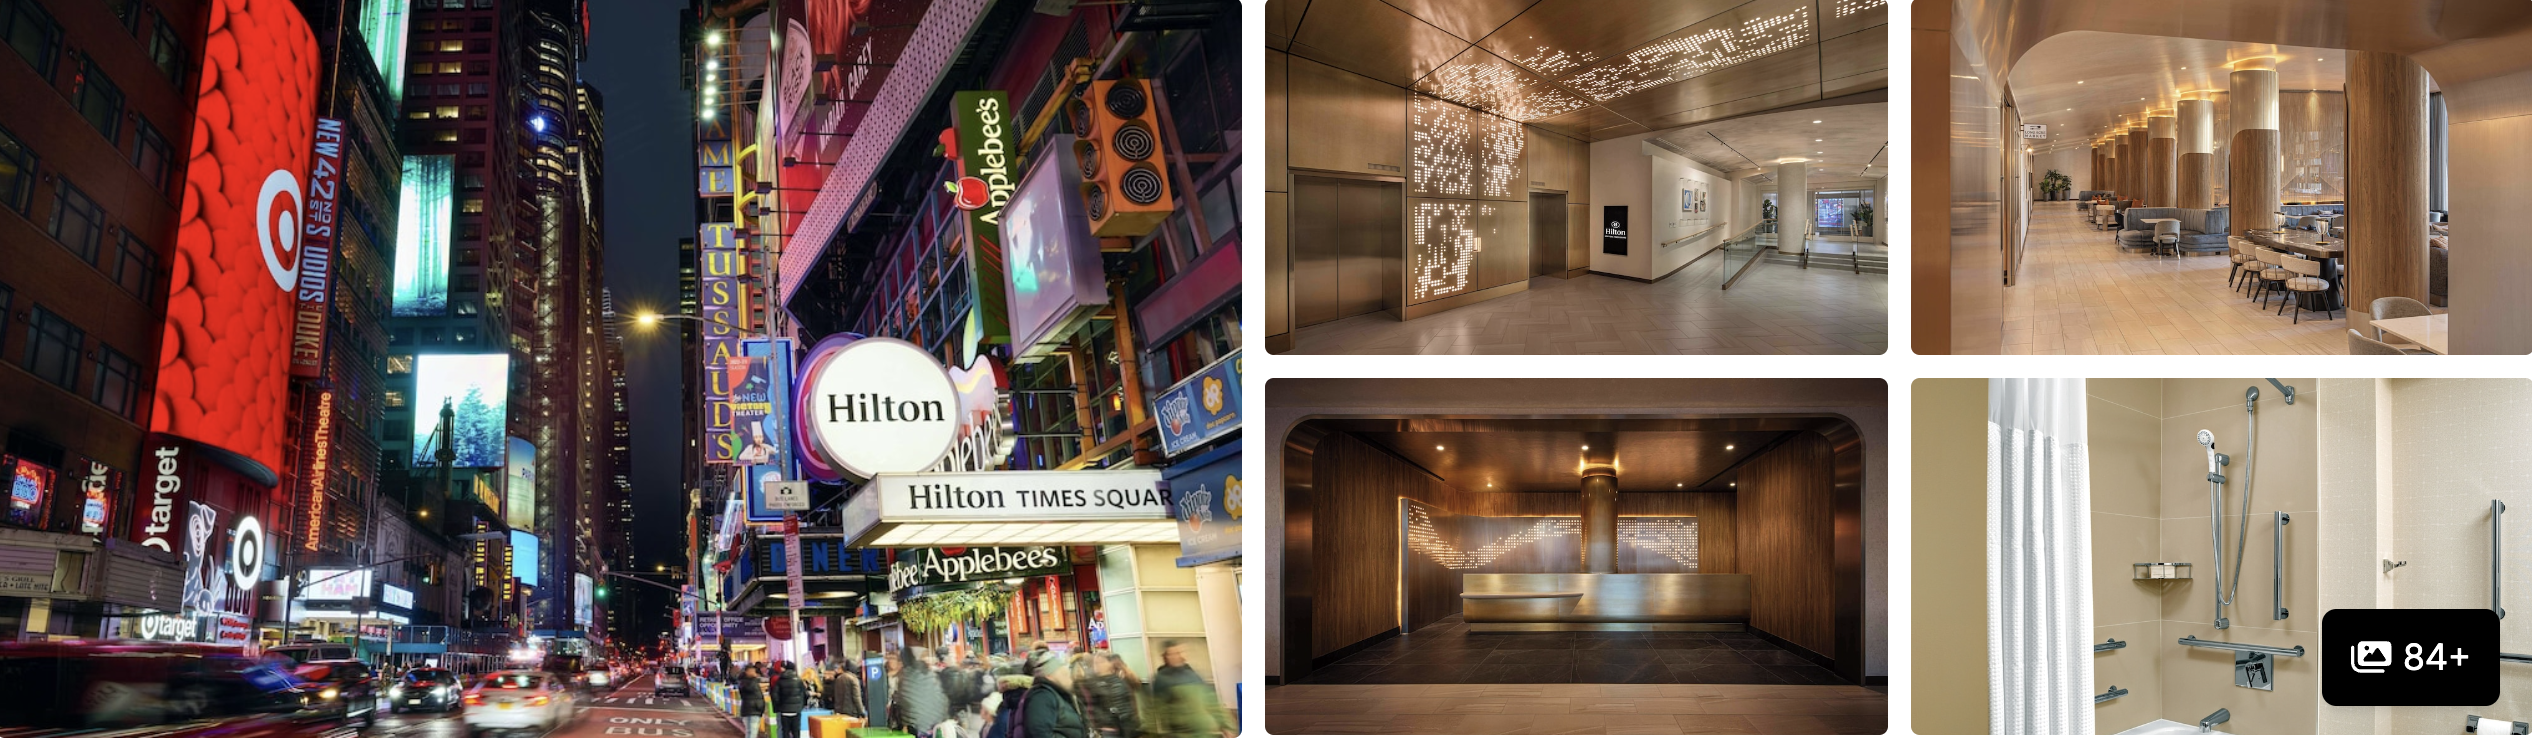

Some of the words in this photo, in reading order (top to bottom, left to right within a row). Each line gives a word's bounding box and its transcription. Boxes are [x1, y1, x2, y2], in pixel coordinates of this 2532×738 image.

[847, 36, 873, 101] CAREY
[701, 42, 732, 193] MAME
[315, 117, 342, 158] NEW
[1605, 228, 1626, 236] Hilton
[293, 310, 322, 359] DUKE
[742, 392, 766, 402] NEW
[828, 393, 945, 423] Hilton
[144, 446, 182, 536] target
[908, 485, 1005, 510] Hilton
[1016, 489, 1086, 508] TIMES
[1094, 489, 1174, 510] SQUAR
[476, 524, 487, 563] VICTY
[770, 541, 880, 573] DNER
[159, 612, 198, 641] target
[604, 726, 694, 738] BUS
[609, 717, 691, 726] ONLY
